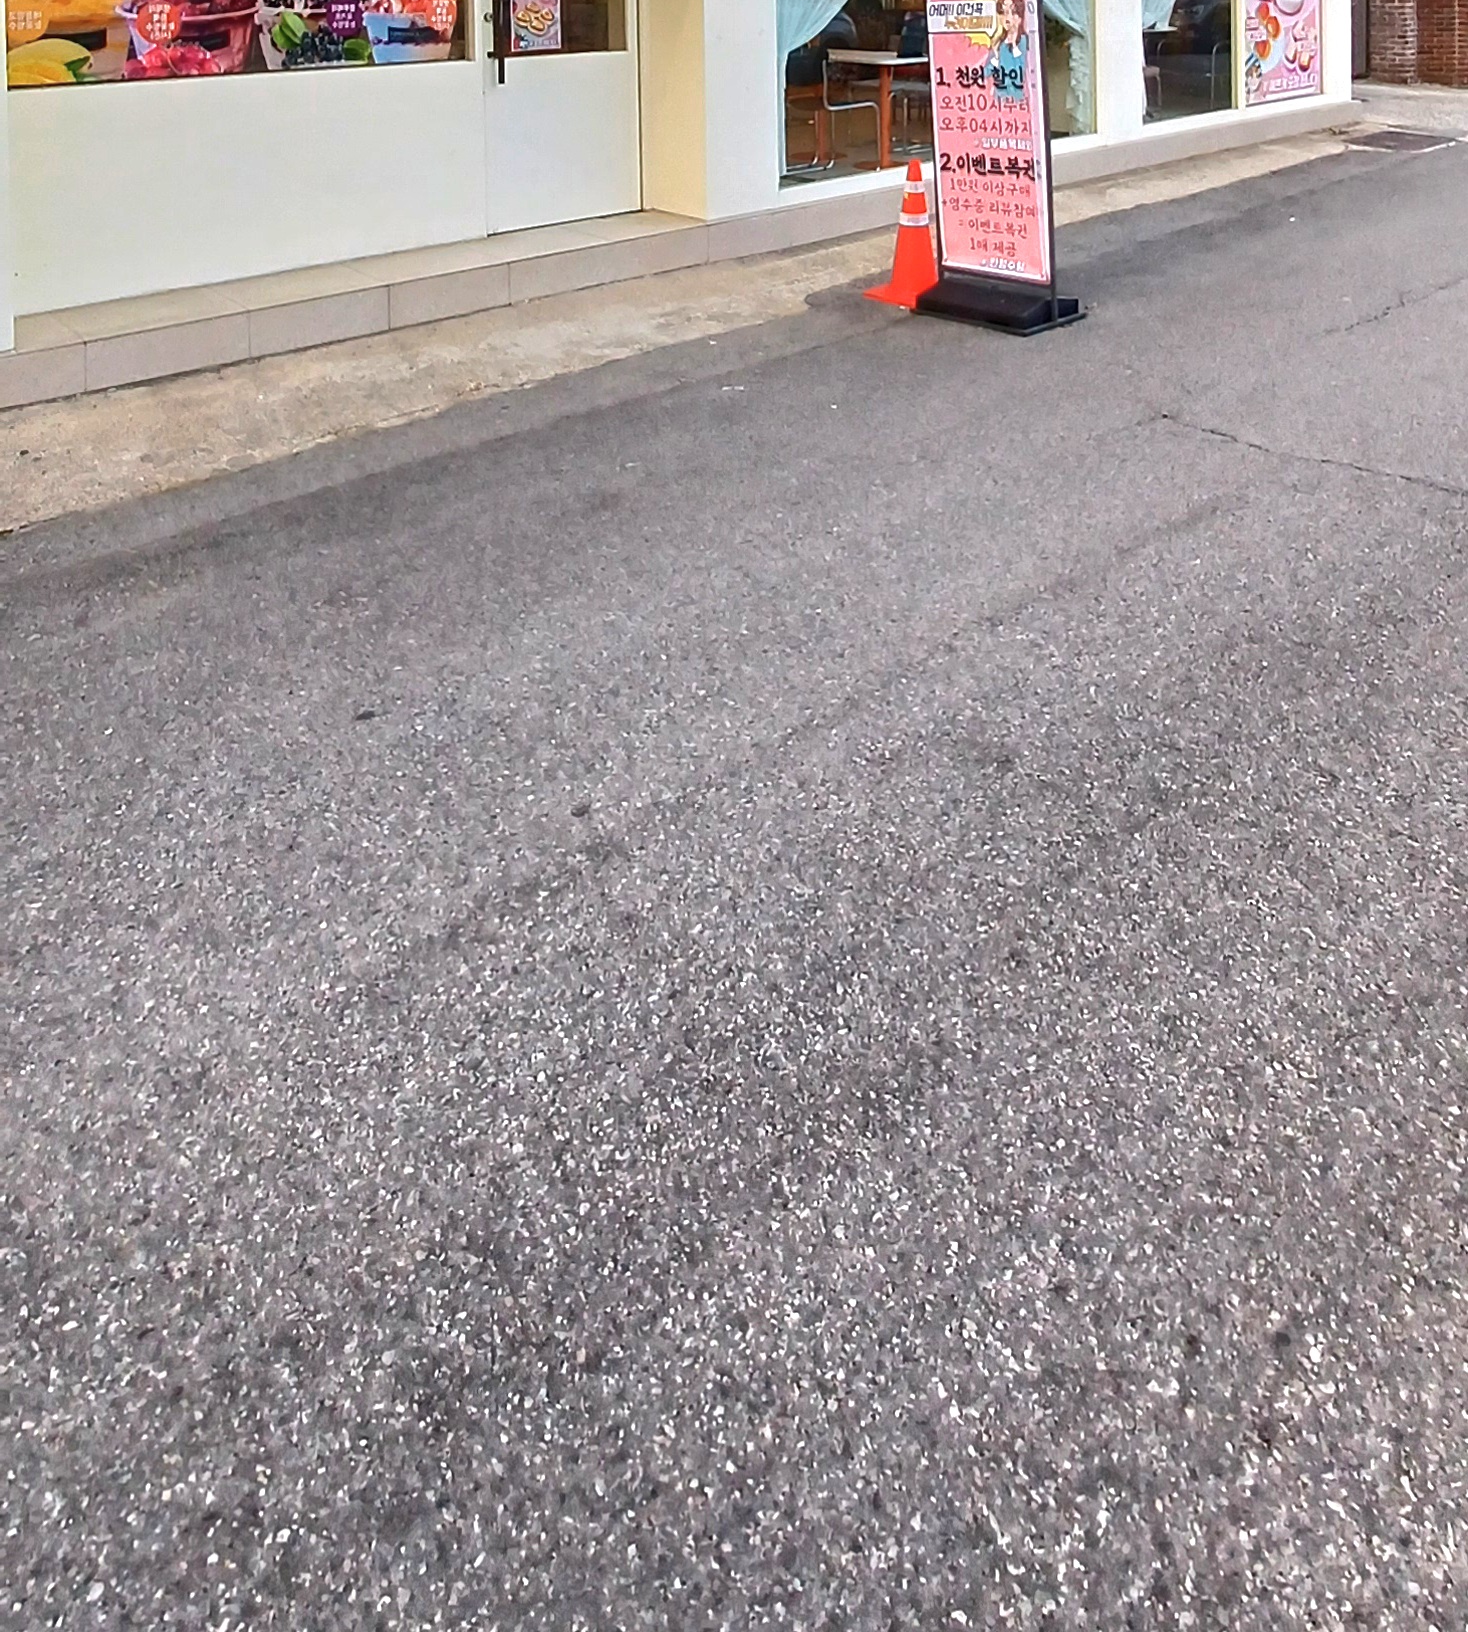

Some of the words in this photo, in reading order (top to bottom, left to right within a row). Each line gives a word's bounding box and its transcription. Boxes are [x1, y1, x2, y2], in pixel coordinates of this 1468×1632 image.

[936, 67, 951, 88] 1.
[956, 65, 986, 89] 천원
[939, 116, 1032, 136] 오후04시까지
